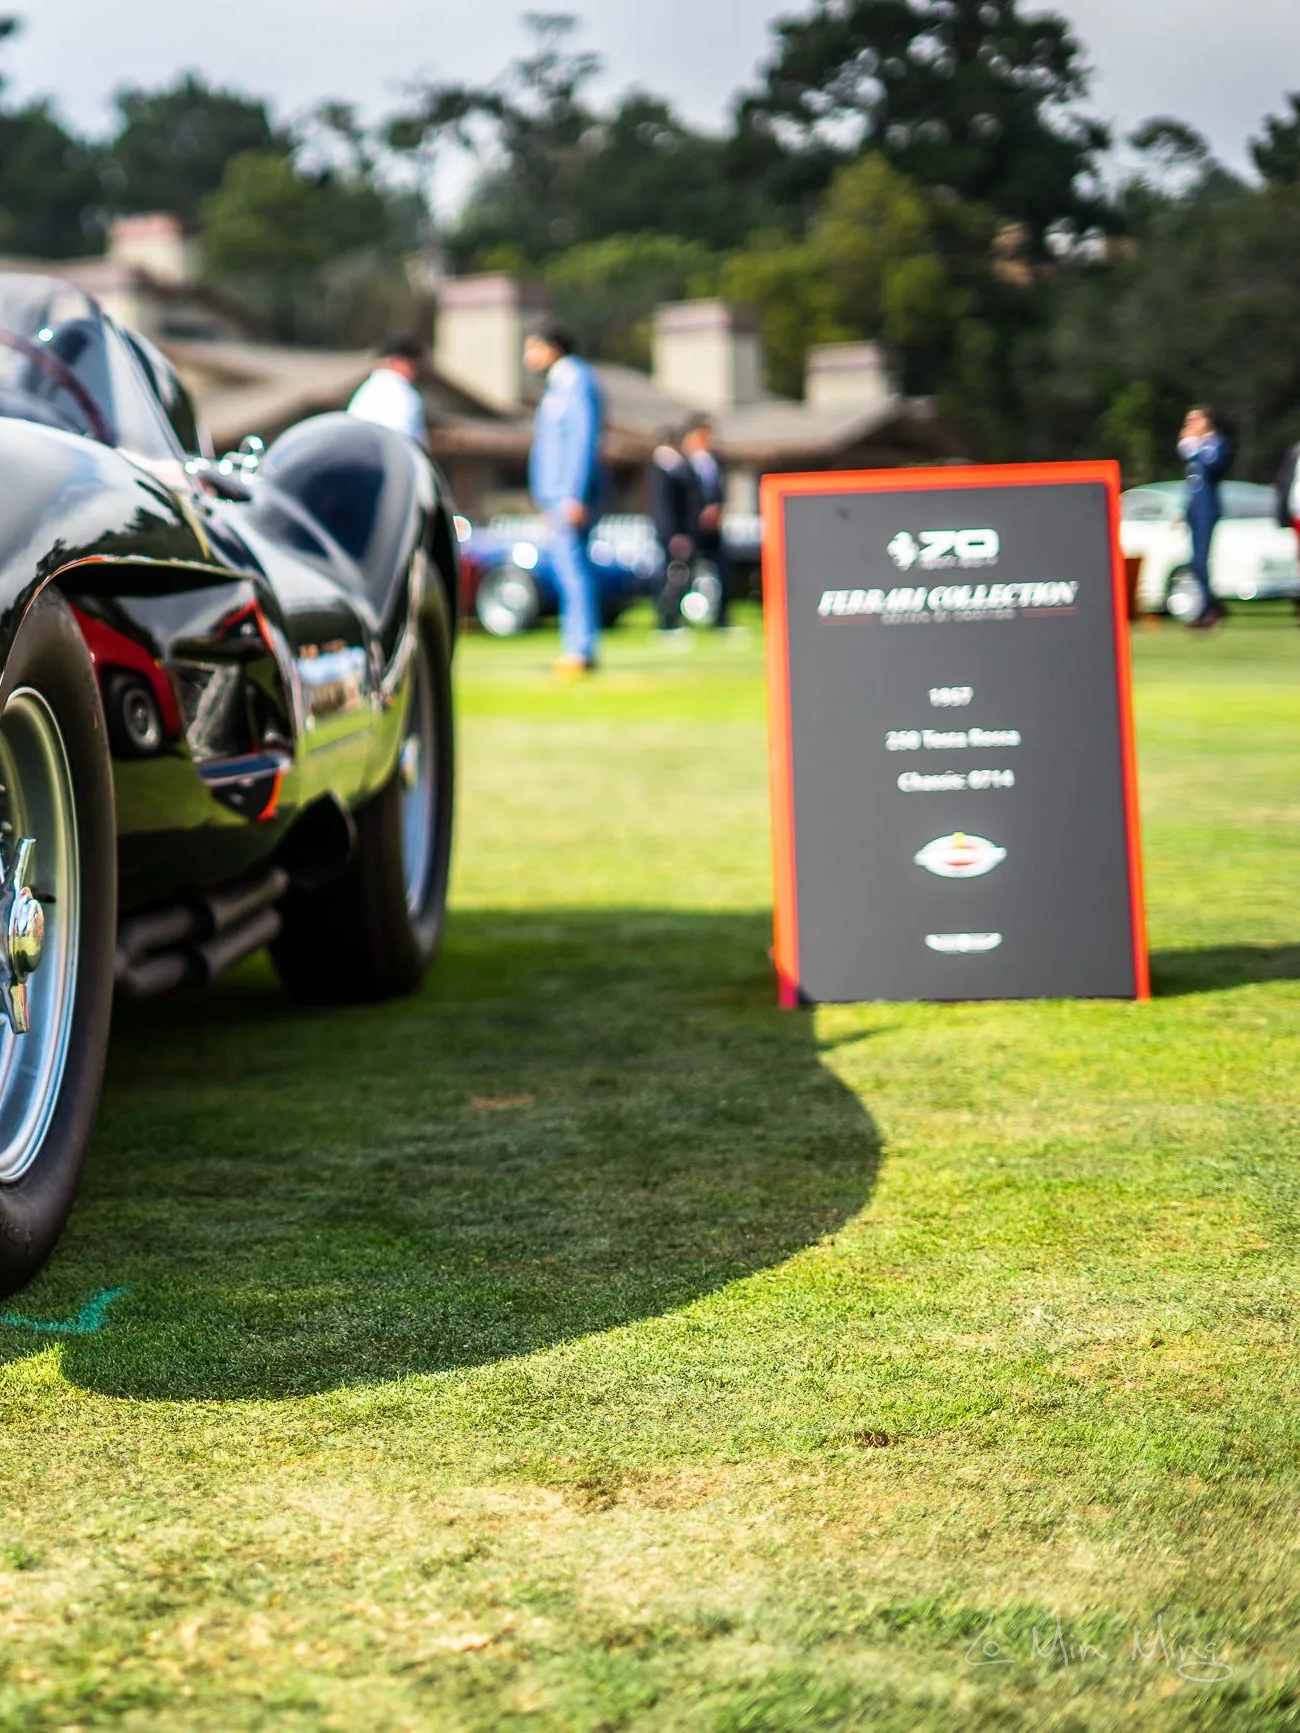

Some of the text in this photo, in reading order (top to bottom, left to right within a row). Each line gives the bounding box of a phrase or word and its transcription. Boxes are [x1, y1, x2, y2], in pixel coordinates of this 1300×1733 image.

[918, 528, 1000, 560] 70
[818, 581, 1079, 616] FERRARI COLLECTION
